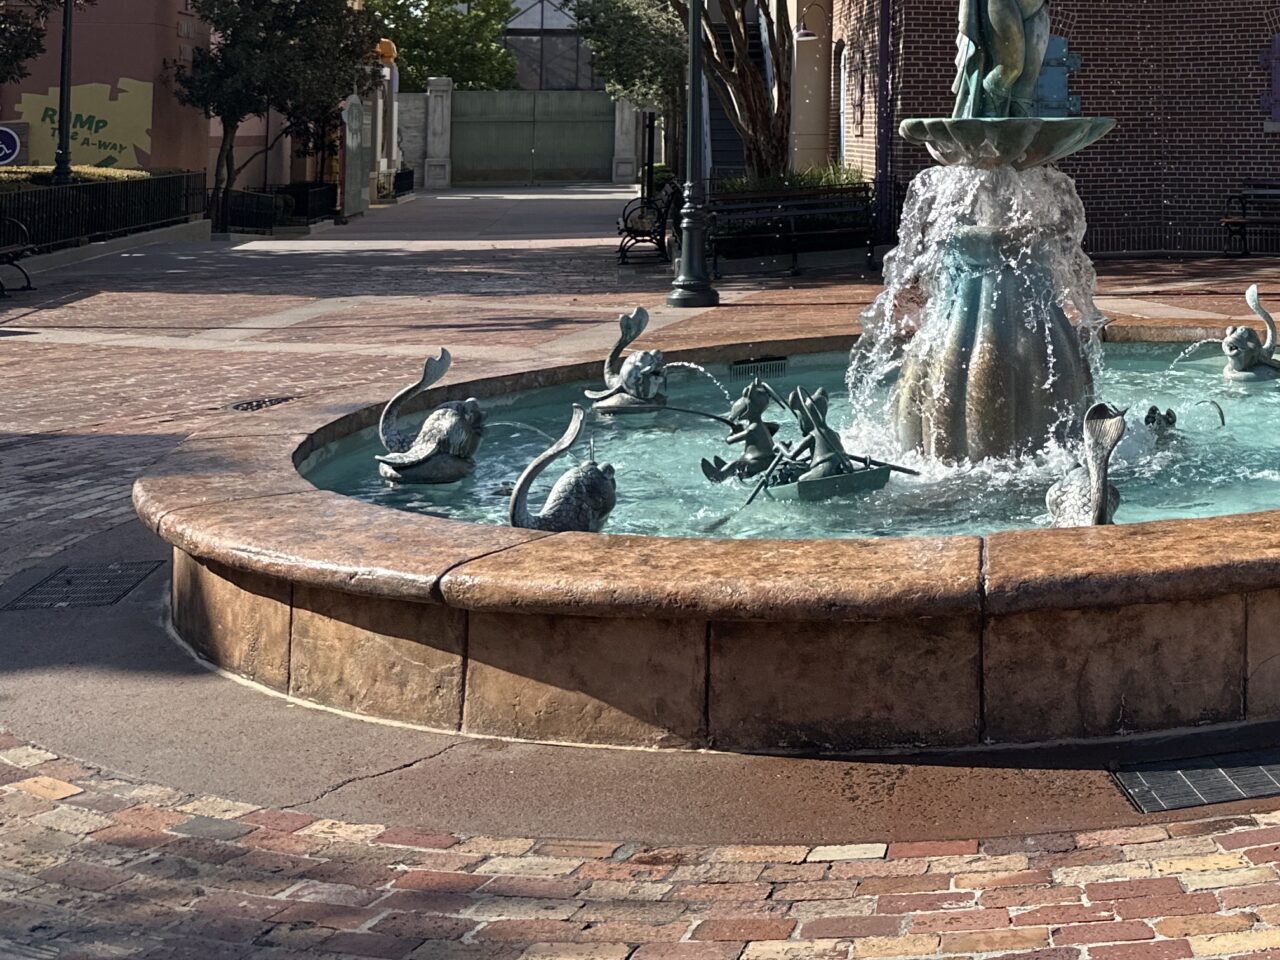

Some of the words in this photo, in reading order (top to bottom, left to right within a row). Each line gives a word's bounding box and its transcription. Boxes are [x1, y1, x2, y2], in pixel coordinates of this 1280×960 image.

[41, 106, 109, 134] RMP
[50, 127, 79, 141] TS
[81, 137, 127, 154] A-WAY
